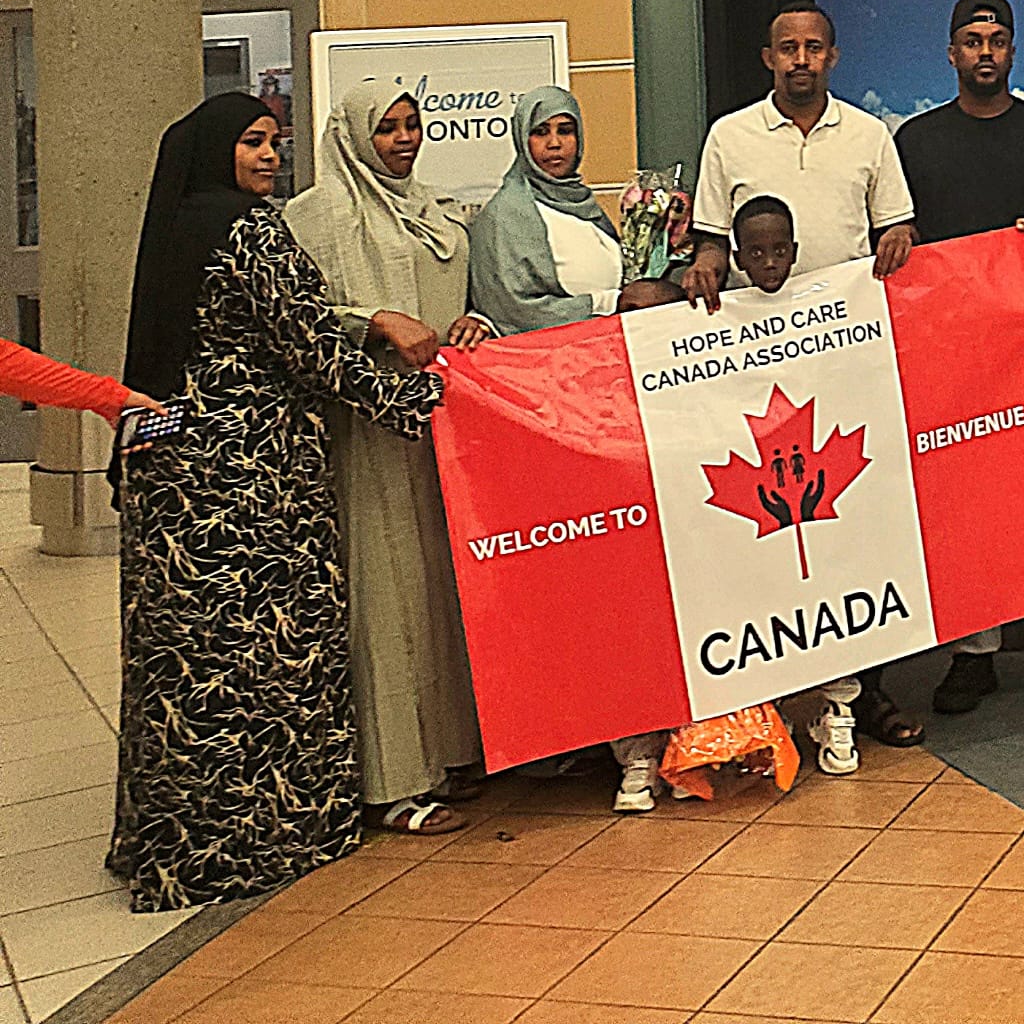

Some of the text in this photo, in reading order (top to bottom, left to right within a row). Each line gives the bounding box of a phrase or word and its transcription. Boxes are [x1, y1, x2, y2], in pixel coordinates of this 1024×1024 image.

[426, 117, 515, 142] ONTO
[641, 321, 882, 392] CANADA ASSOCIATION
[672, 301, 848, 357] HOPE AND CARE
[468, 504, 648, 561] WELCOME TO
[700, 581, 910, 676] CANADA
